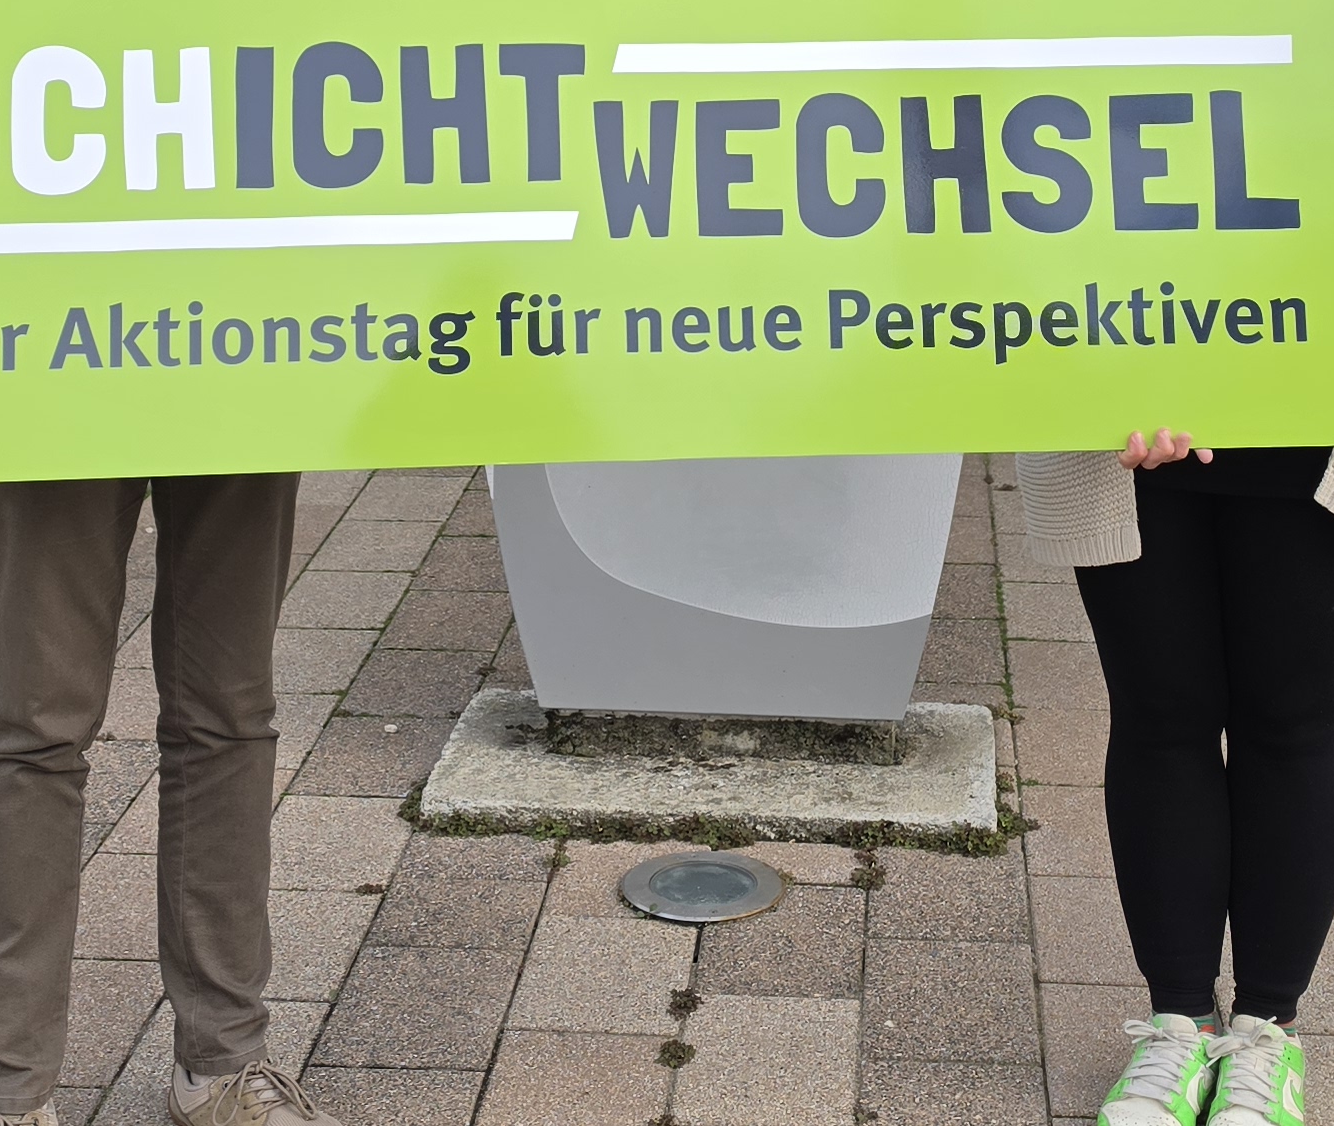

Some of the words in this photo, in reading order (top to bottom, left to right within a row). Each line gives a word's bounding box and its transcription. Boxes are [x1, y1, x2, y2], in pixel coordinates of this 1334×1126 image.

[50, 301, 474, 374] Aktionstag
[496, 293, 601, 356] für
[625, 305, 802, 354] neue
[828, 282, 1308, 365] Perspektiven
